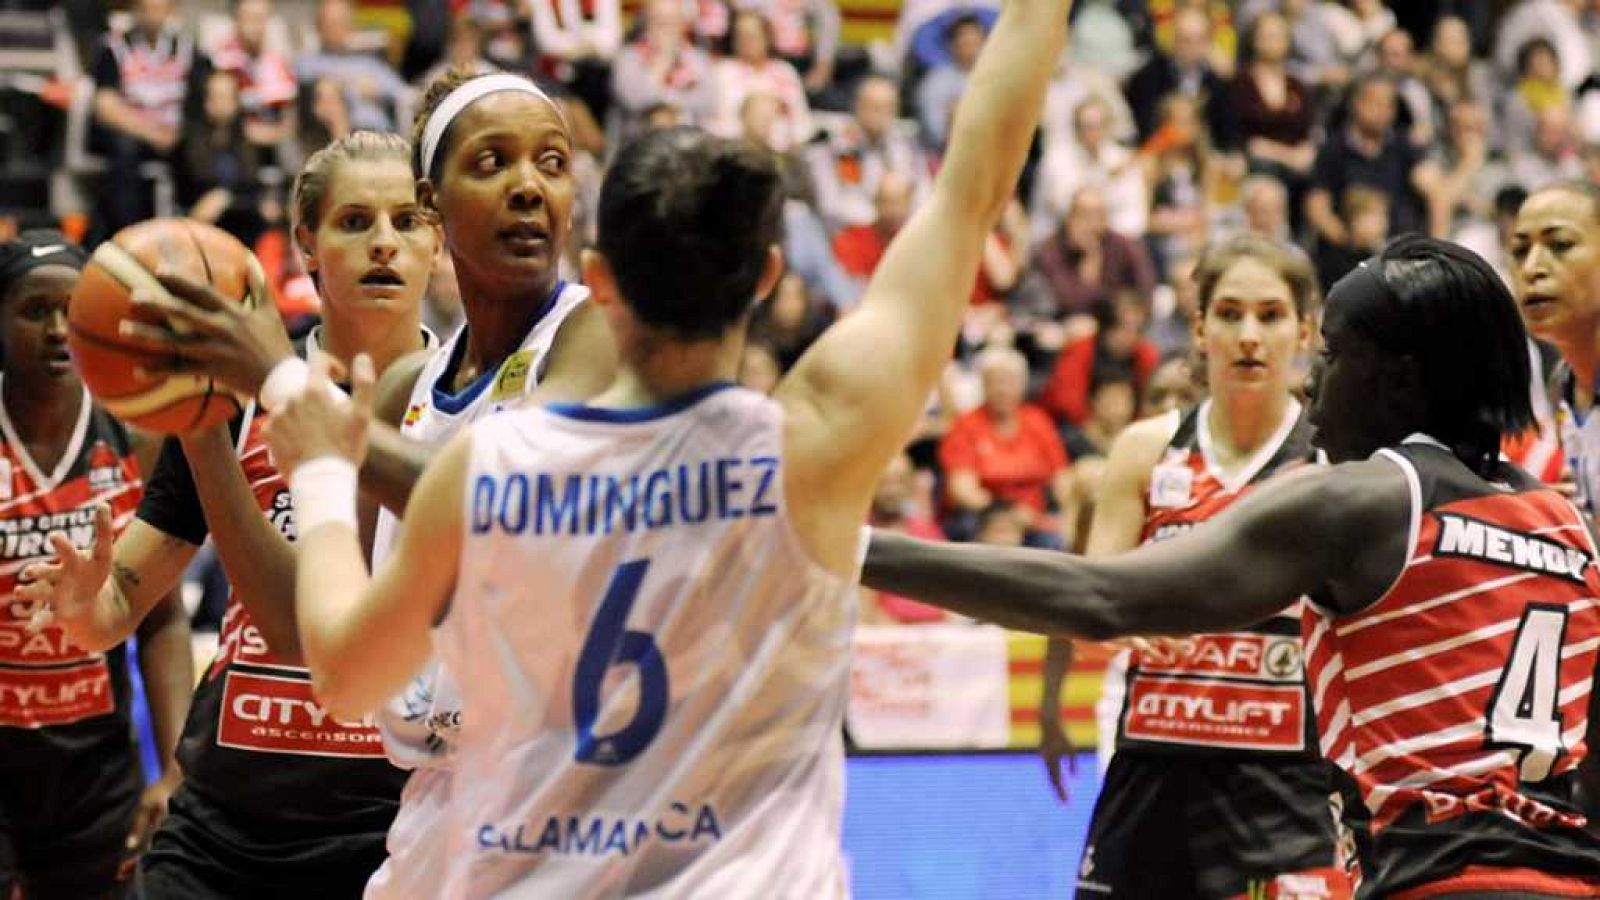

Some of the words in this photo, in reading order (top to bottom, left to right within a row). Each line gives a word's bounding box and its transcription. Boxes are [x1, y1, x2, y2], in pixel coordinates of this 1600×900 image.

[472, 456, 779, 535] DOMINGUEZ
[573, 558, 669, 768] 6
[1489, 606, 1566, 782] 4
